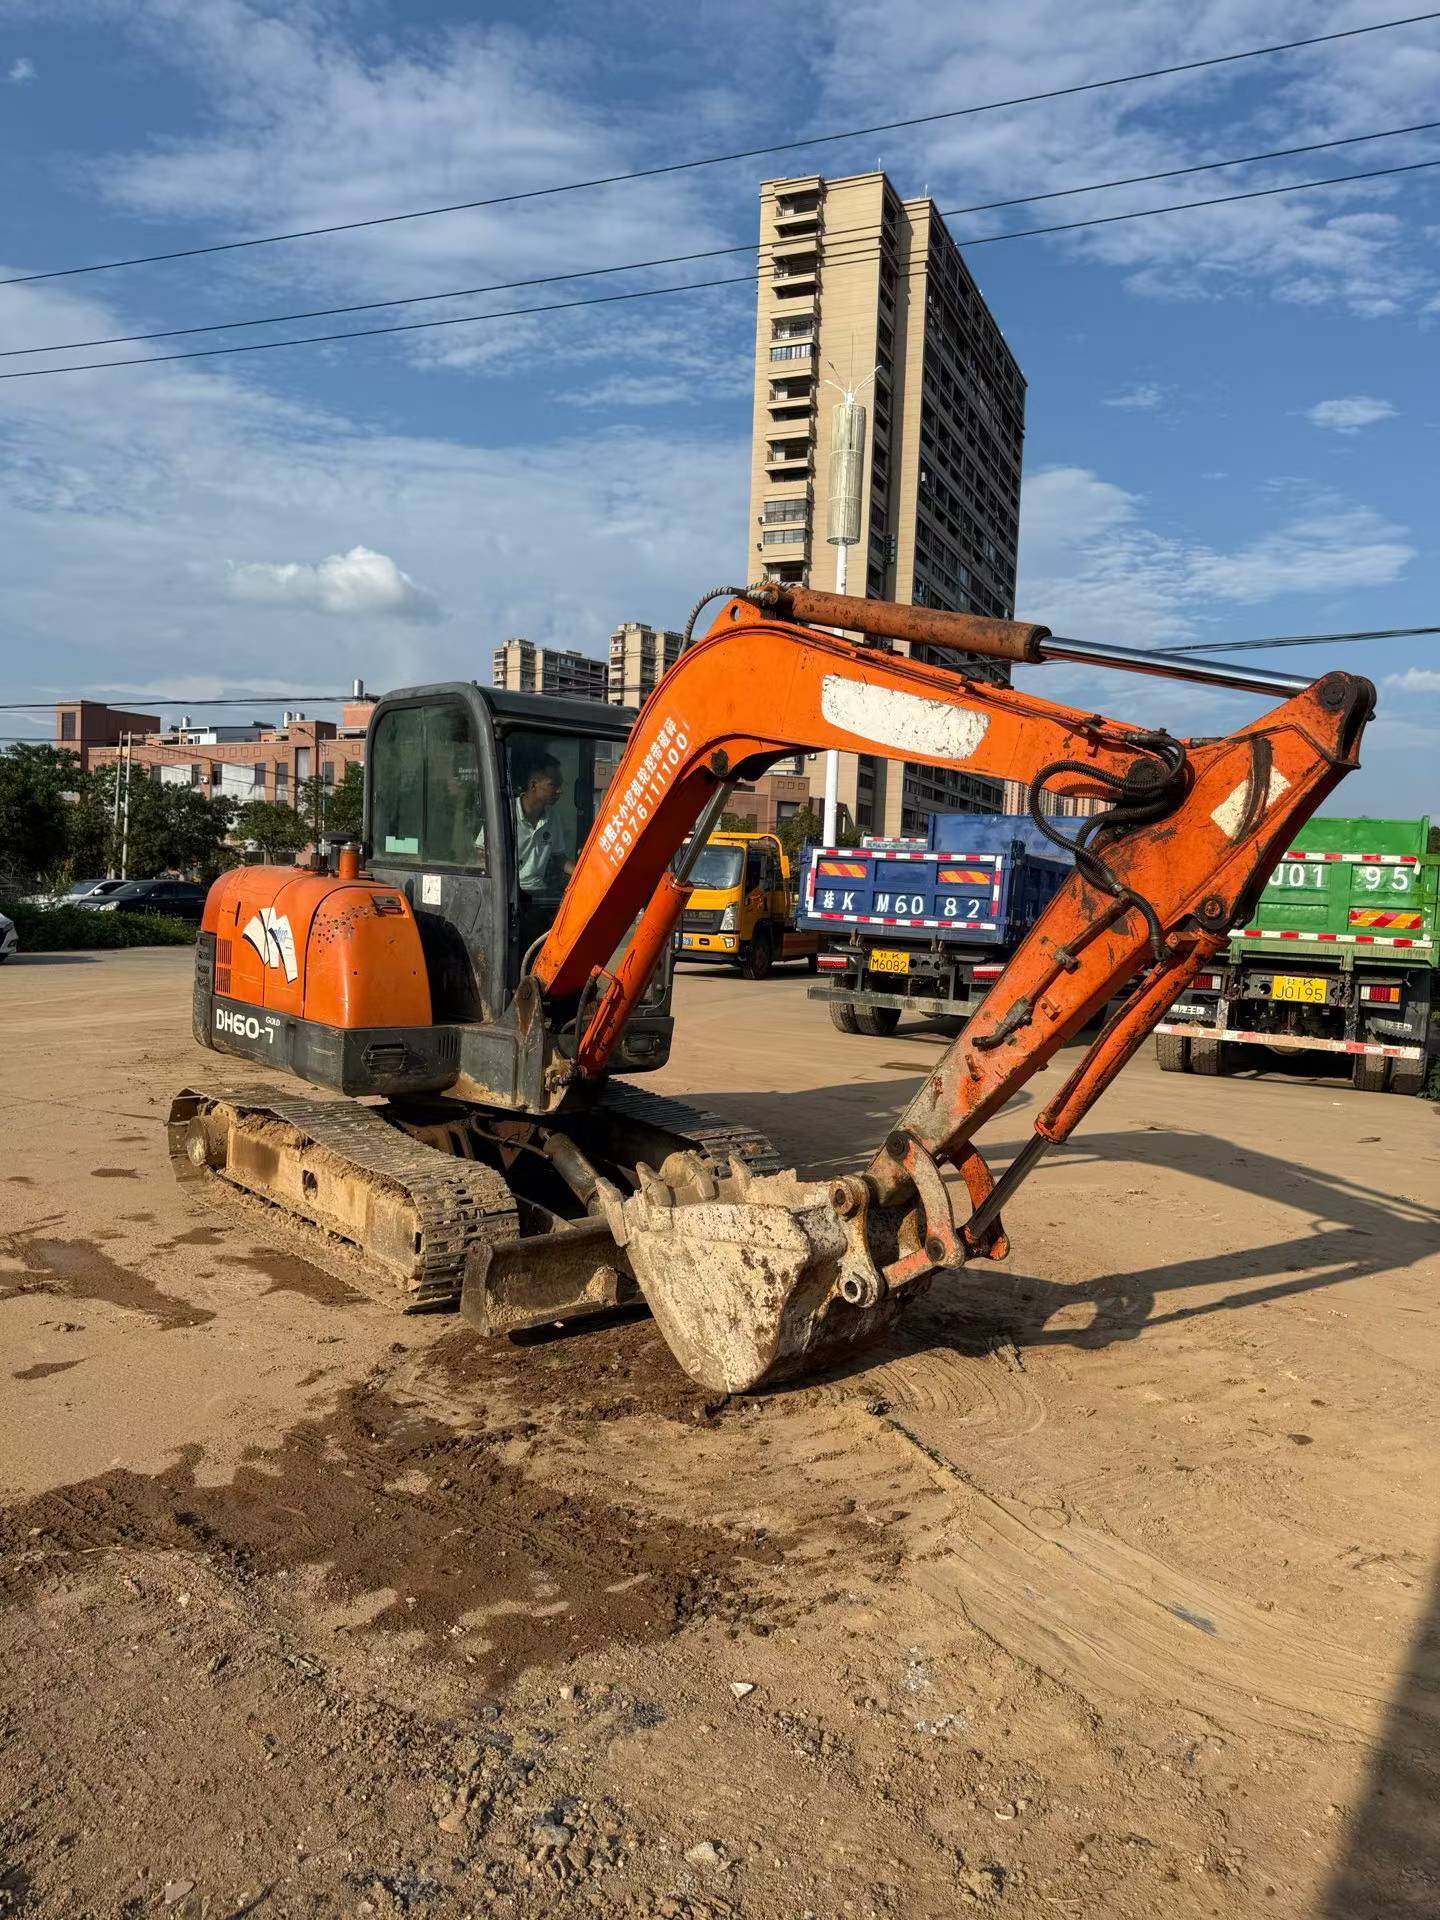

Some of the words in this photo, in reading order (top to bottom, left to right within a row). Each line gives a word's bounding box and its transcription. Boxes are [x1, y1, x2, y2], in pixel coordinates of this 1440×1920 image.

[609, 732, 688, 867] 15976111100
[872, 958, 907, 972] M6082
[1275, 985, 1323, 1001] J0195
[216, 1008, 274, 1044] DH60-7
[265, 1016, 281, 1027] GOLD
